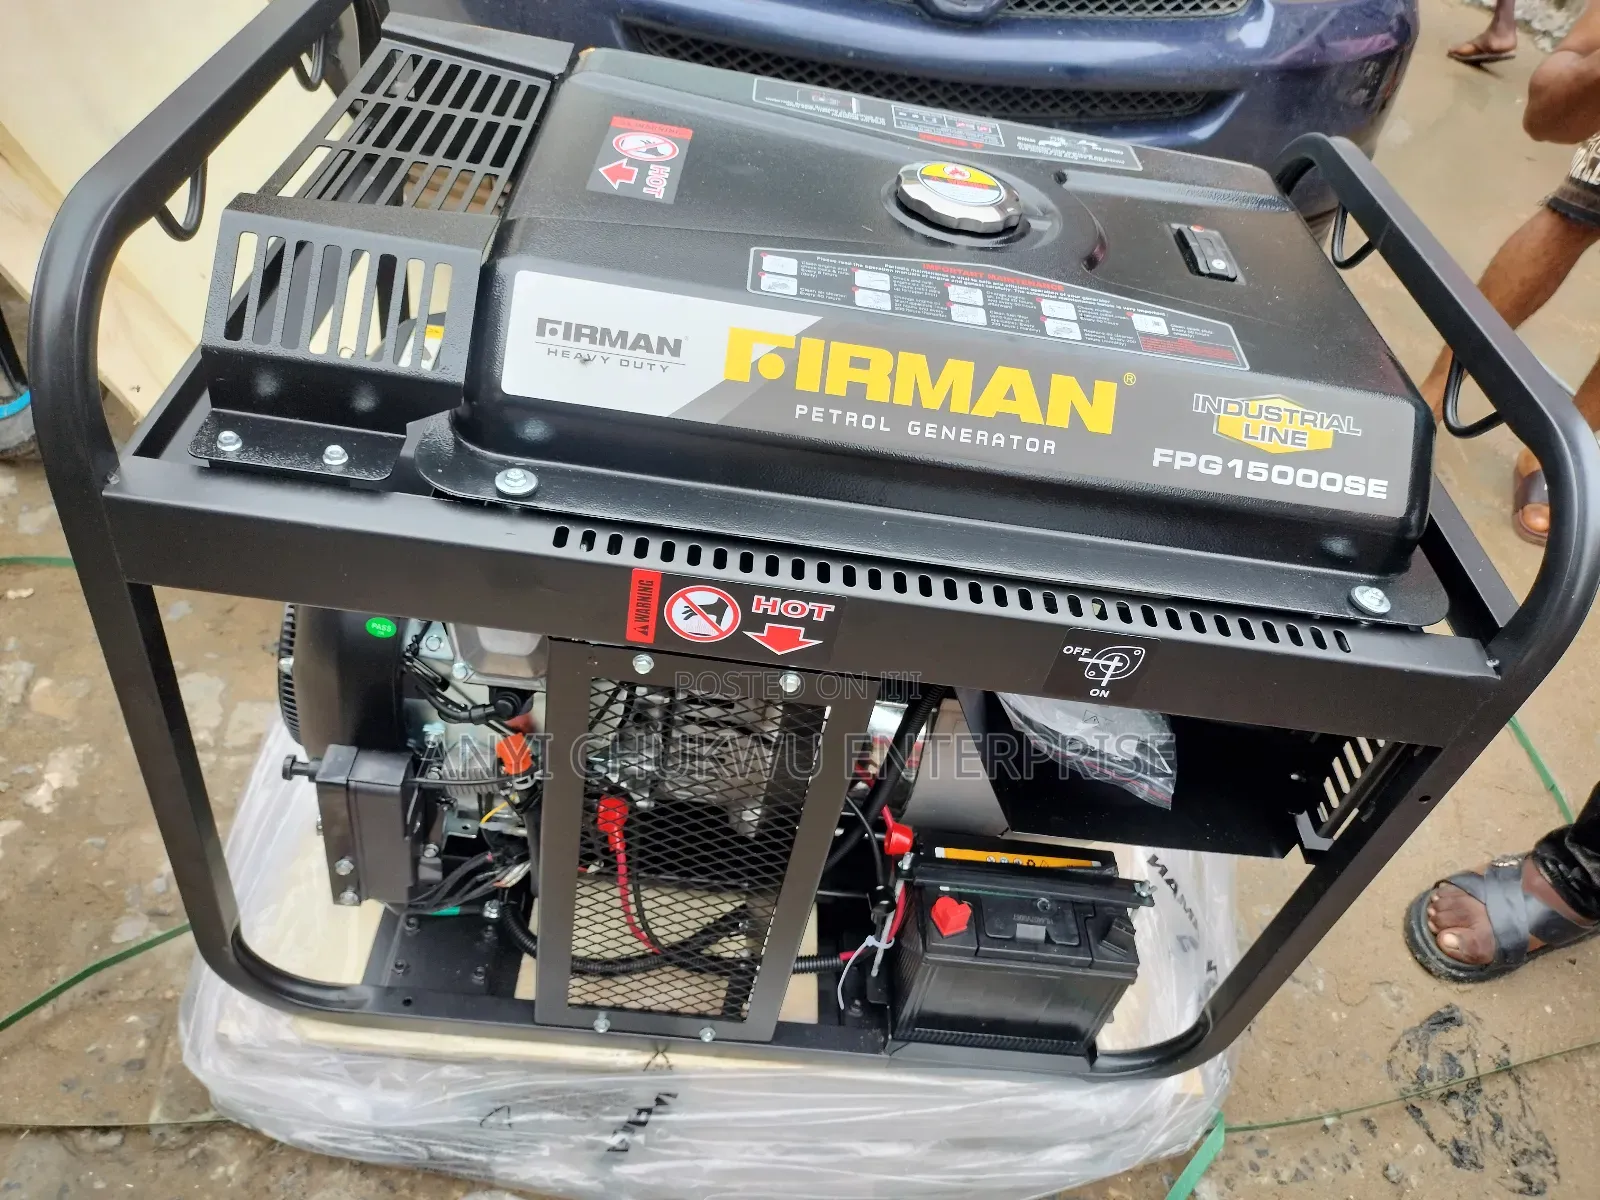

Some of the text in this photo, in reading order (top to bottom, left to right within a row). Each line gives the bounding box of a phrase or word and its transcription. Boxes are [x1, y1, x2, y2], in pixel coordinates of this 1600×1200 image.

[643, 164, 671, 199] HOT
[816, 256, 837, 264] Please
[864, 264, 894, 273] operation
[922, 263, 1064, 291] IMPORTANT MAINTENANCE
[535, 317, 683, 358] FIRMAN
[547, 347, 669, 373] HEAVY DUTY
[723, 326, 1118, 435] FIRMAN
[794, 404, 1056, 455] PETROL GENERATOR
[1192, 393, 1362, 436] INDUSTRIAL
[1243, 422, 1308, 449] LINE
[1152, 447, 1389, 500] FPG15000SE
[635, 579, 654, 622] WARNING
[751, 594, 835, 622] HOT
[1062, 645, 1092, 656] OFF
[1089, 688, 1110, 698] ON
